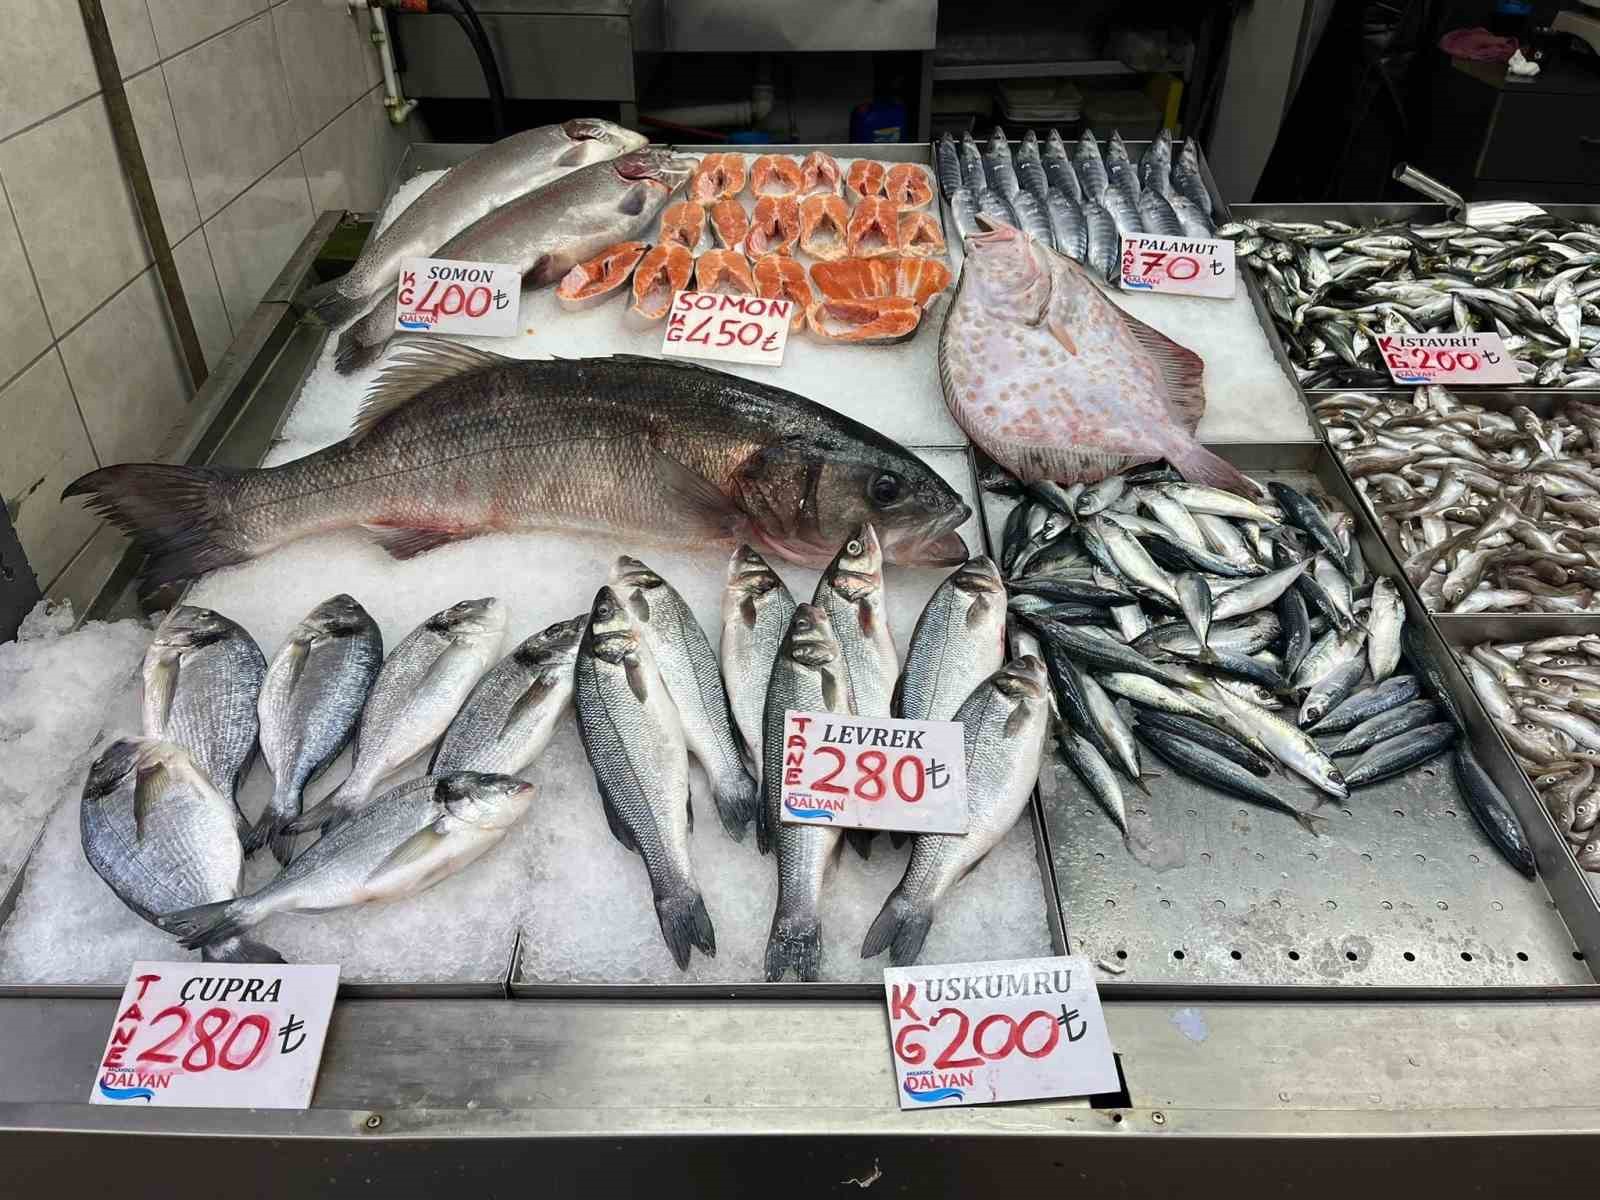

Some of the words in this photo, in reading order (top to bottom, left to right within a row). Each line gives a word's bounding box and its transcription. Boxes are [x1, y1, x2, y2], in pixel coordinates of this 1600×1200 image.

[1139, 239, 1218, 255] PALAMUT
[399, 271, 415, 305] KG
[427, 266, 494, 283] SOMON
[676, 292, 789, 318] SOMON
[667, 313, 686, 341] KG
[823, 724, 926, 749] LEVREK
[784, 718, 812, 785] TANE
[787, 797, 844, 811] DALYAN
[179, 977, 283, 1007] ÇUPRA
[924, 970, 1072, 1002] USKUMRU
[103, 974, 161, 1068] TANE
[891, 983, 930, 1065] KG
[104, 1072, 171, 1089] DALYAN
[906, 1072, 974, 1089] DALYAN
